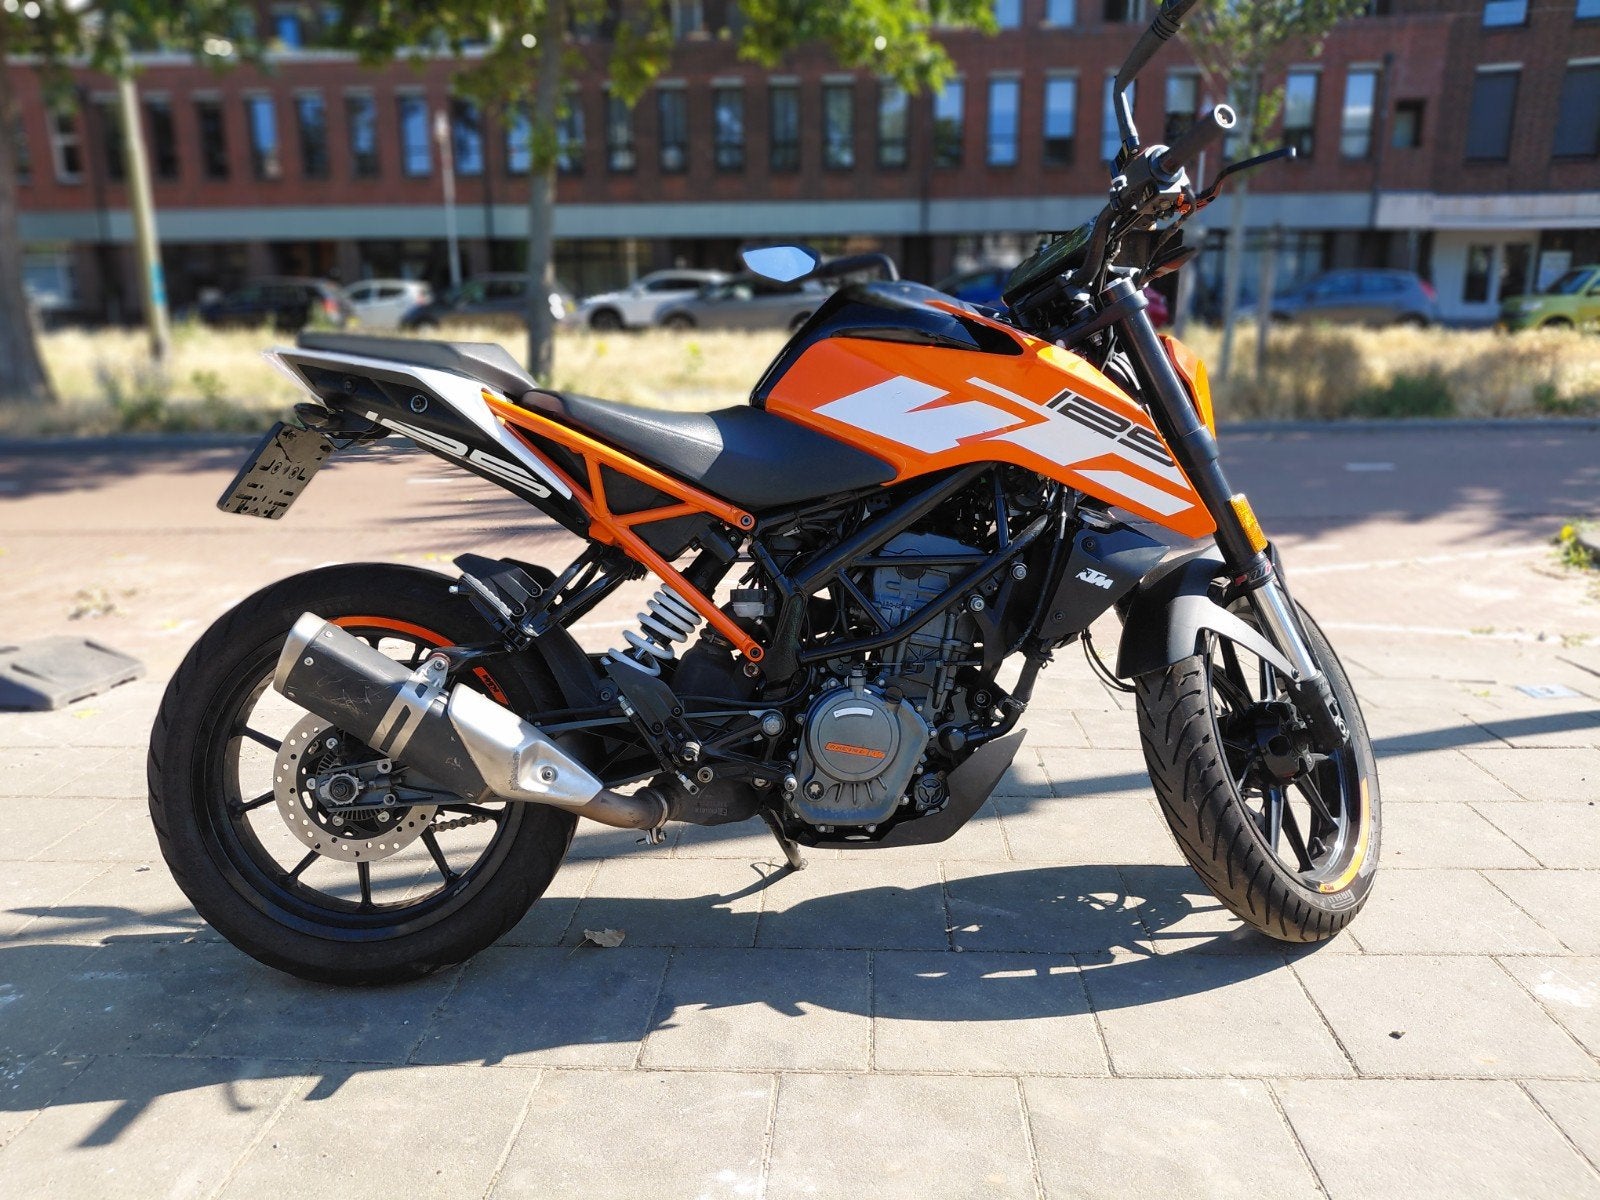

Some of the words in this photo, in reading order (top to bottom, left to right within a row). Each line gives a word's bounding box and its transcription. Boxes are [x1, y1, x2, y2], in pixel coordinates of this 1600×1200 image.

[1046, 390, 1177, 468] 125
[1075, 567, 1114, 590] KTM
[1328, 889, 1356, 909] PIRELLI
